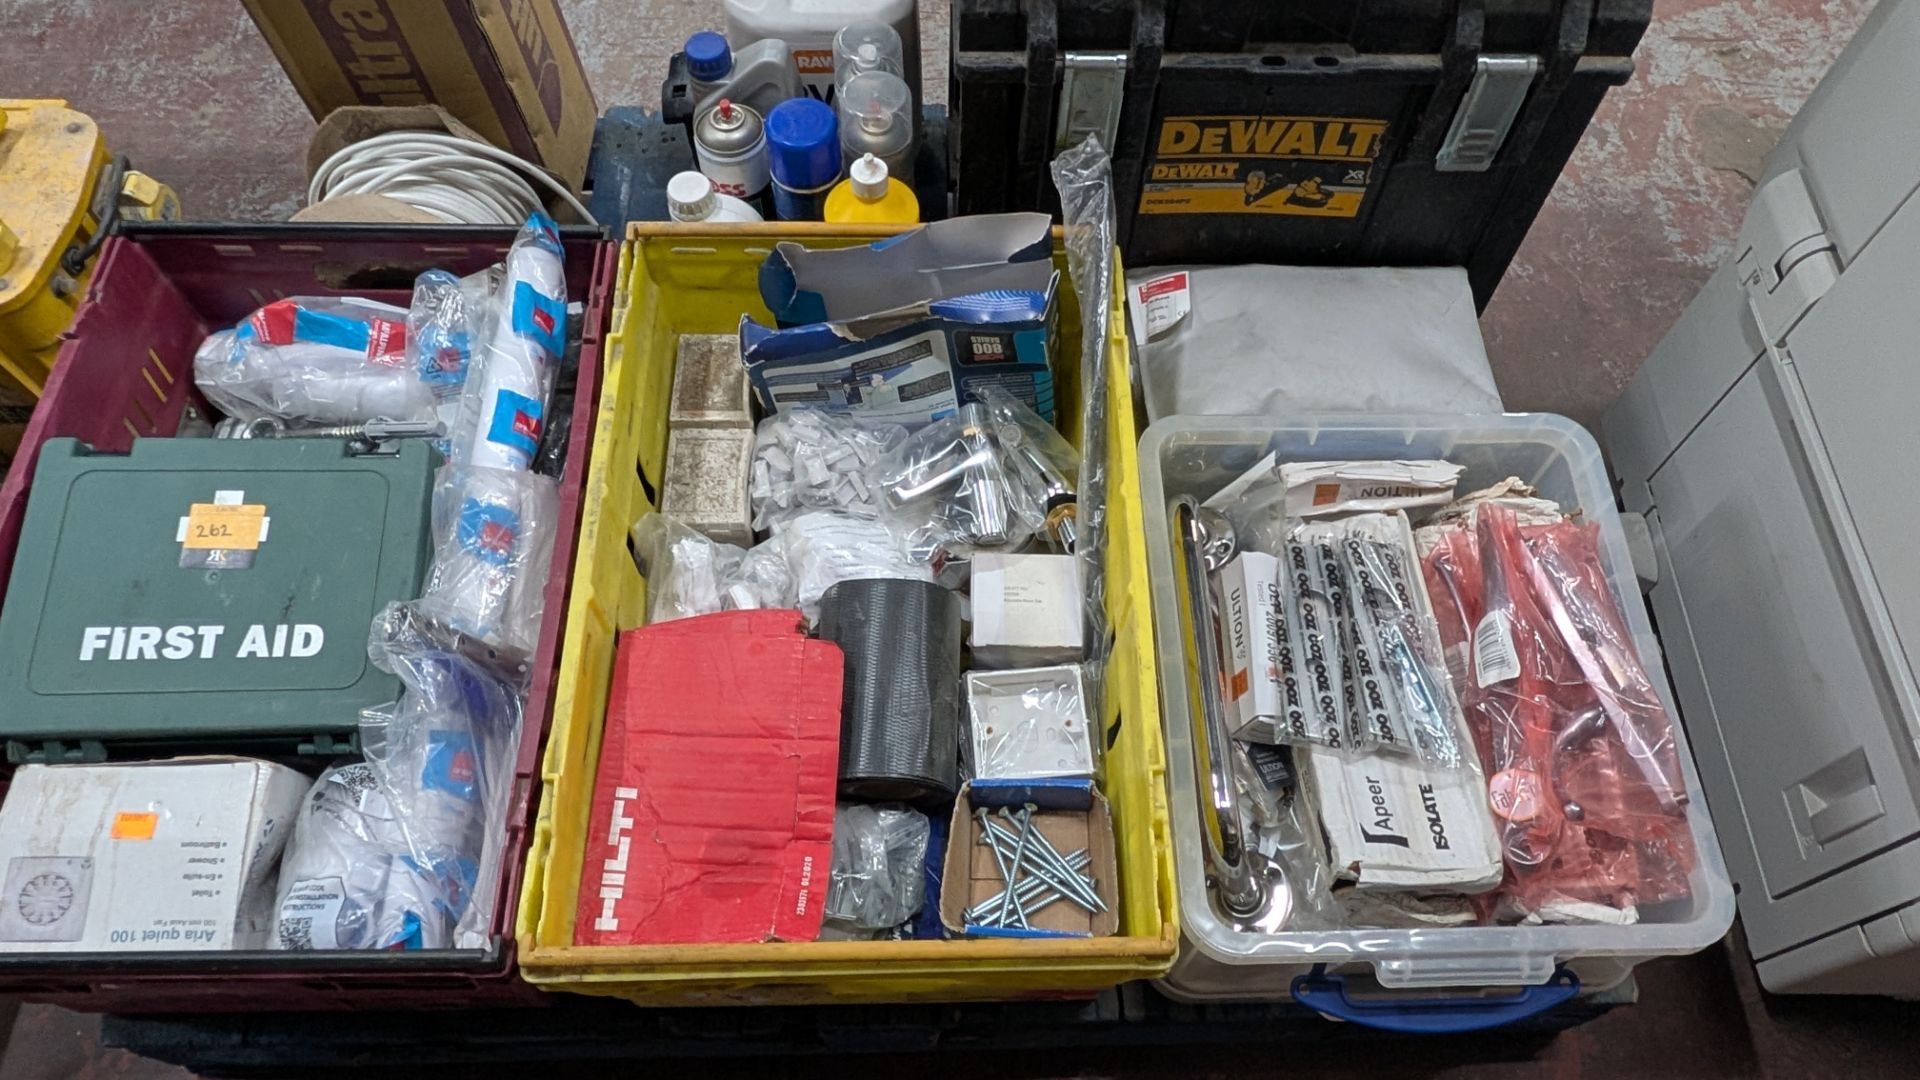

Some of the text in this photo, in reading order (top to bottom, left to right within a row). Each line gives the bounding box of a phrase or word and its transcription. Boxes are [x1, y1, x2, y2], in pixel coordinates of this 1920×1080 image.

[1157, 121, 1386, 157] DEWALT
[1152, 163, 1239, 180] DEWALT
[973, 343, 1003, 354] 800
[196, 524, 232, 538] 262
[1325, 563, 1340, 588] ZOO
[1385, 553, 1402, 579] ZOO
[1358, 570, 1375, 596] ZOO
[1395, 582, 1411, 609] ZOO
[1230, 588, 1243, 648] ULTION
[79, 624, 324, 661] FIRST AID
[1292, 546, 1341, 748] OO ZOO ZOO ZOO ZOO ZOO ZOO
[1279, 647, 1293, 673] ZOO
[1356, 649, 1373, 677] ZOO
[1285, 677, 1299, 707] ZOO
[1365, 680, 1384, 710] ZOO
[1290, 710, 1306, 739] ZOO
[1376, 713, 1394, 743] ZOO
[1366, 776, 1394, 831] Apeer
[1419, 784, 1450, 850] ISOLATE
[181, 841, 220, 849] Bathroom
[594, 786, 638, 931] HILTI
[188, 857, 218, 865] Shower
[183, 873, 216, 881] En-suite
[192, 889, 214, 897] Toilet
[111, 926, 216, 943] Aria quiet 100
